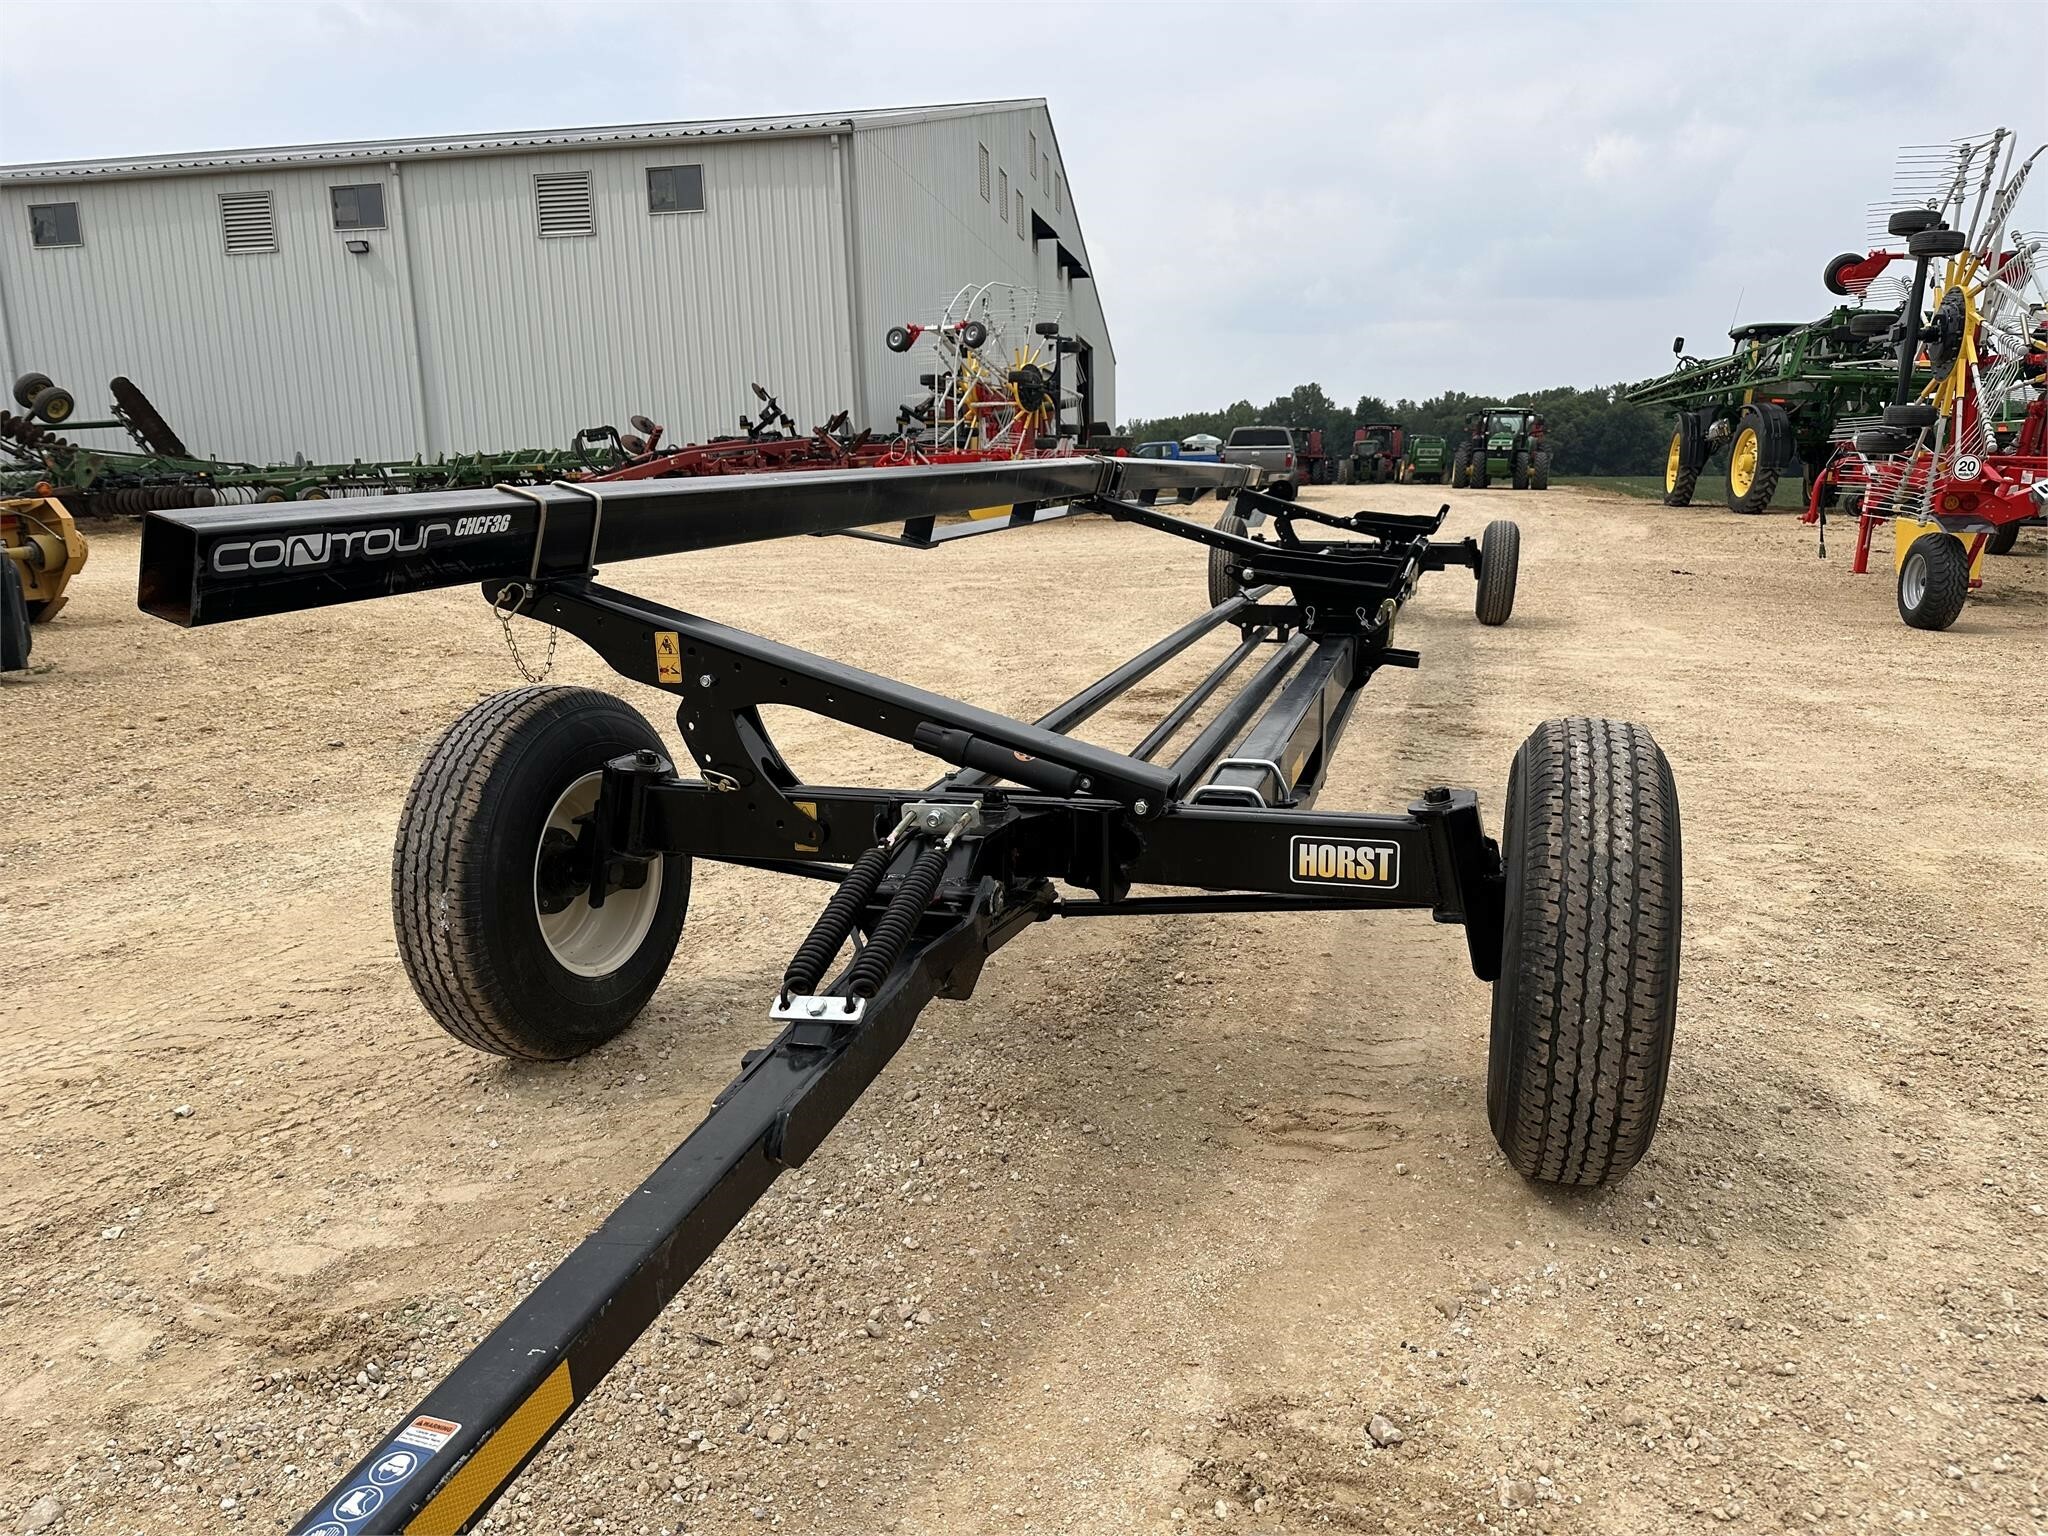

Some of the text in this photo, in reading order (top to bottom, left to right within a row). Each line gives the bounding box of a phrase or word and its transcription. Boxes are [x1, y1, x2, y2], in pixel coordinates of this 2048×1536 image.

[1958, 461, 1976, 472] 20
[454, 514, 511, 537] CHCF36
[1298, 843, 1394, 881] HORST
[423, 1421, 453, 1432] WARNING
